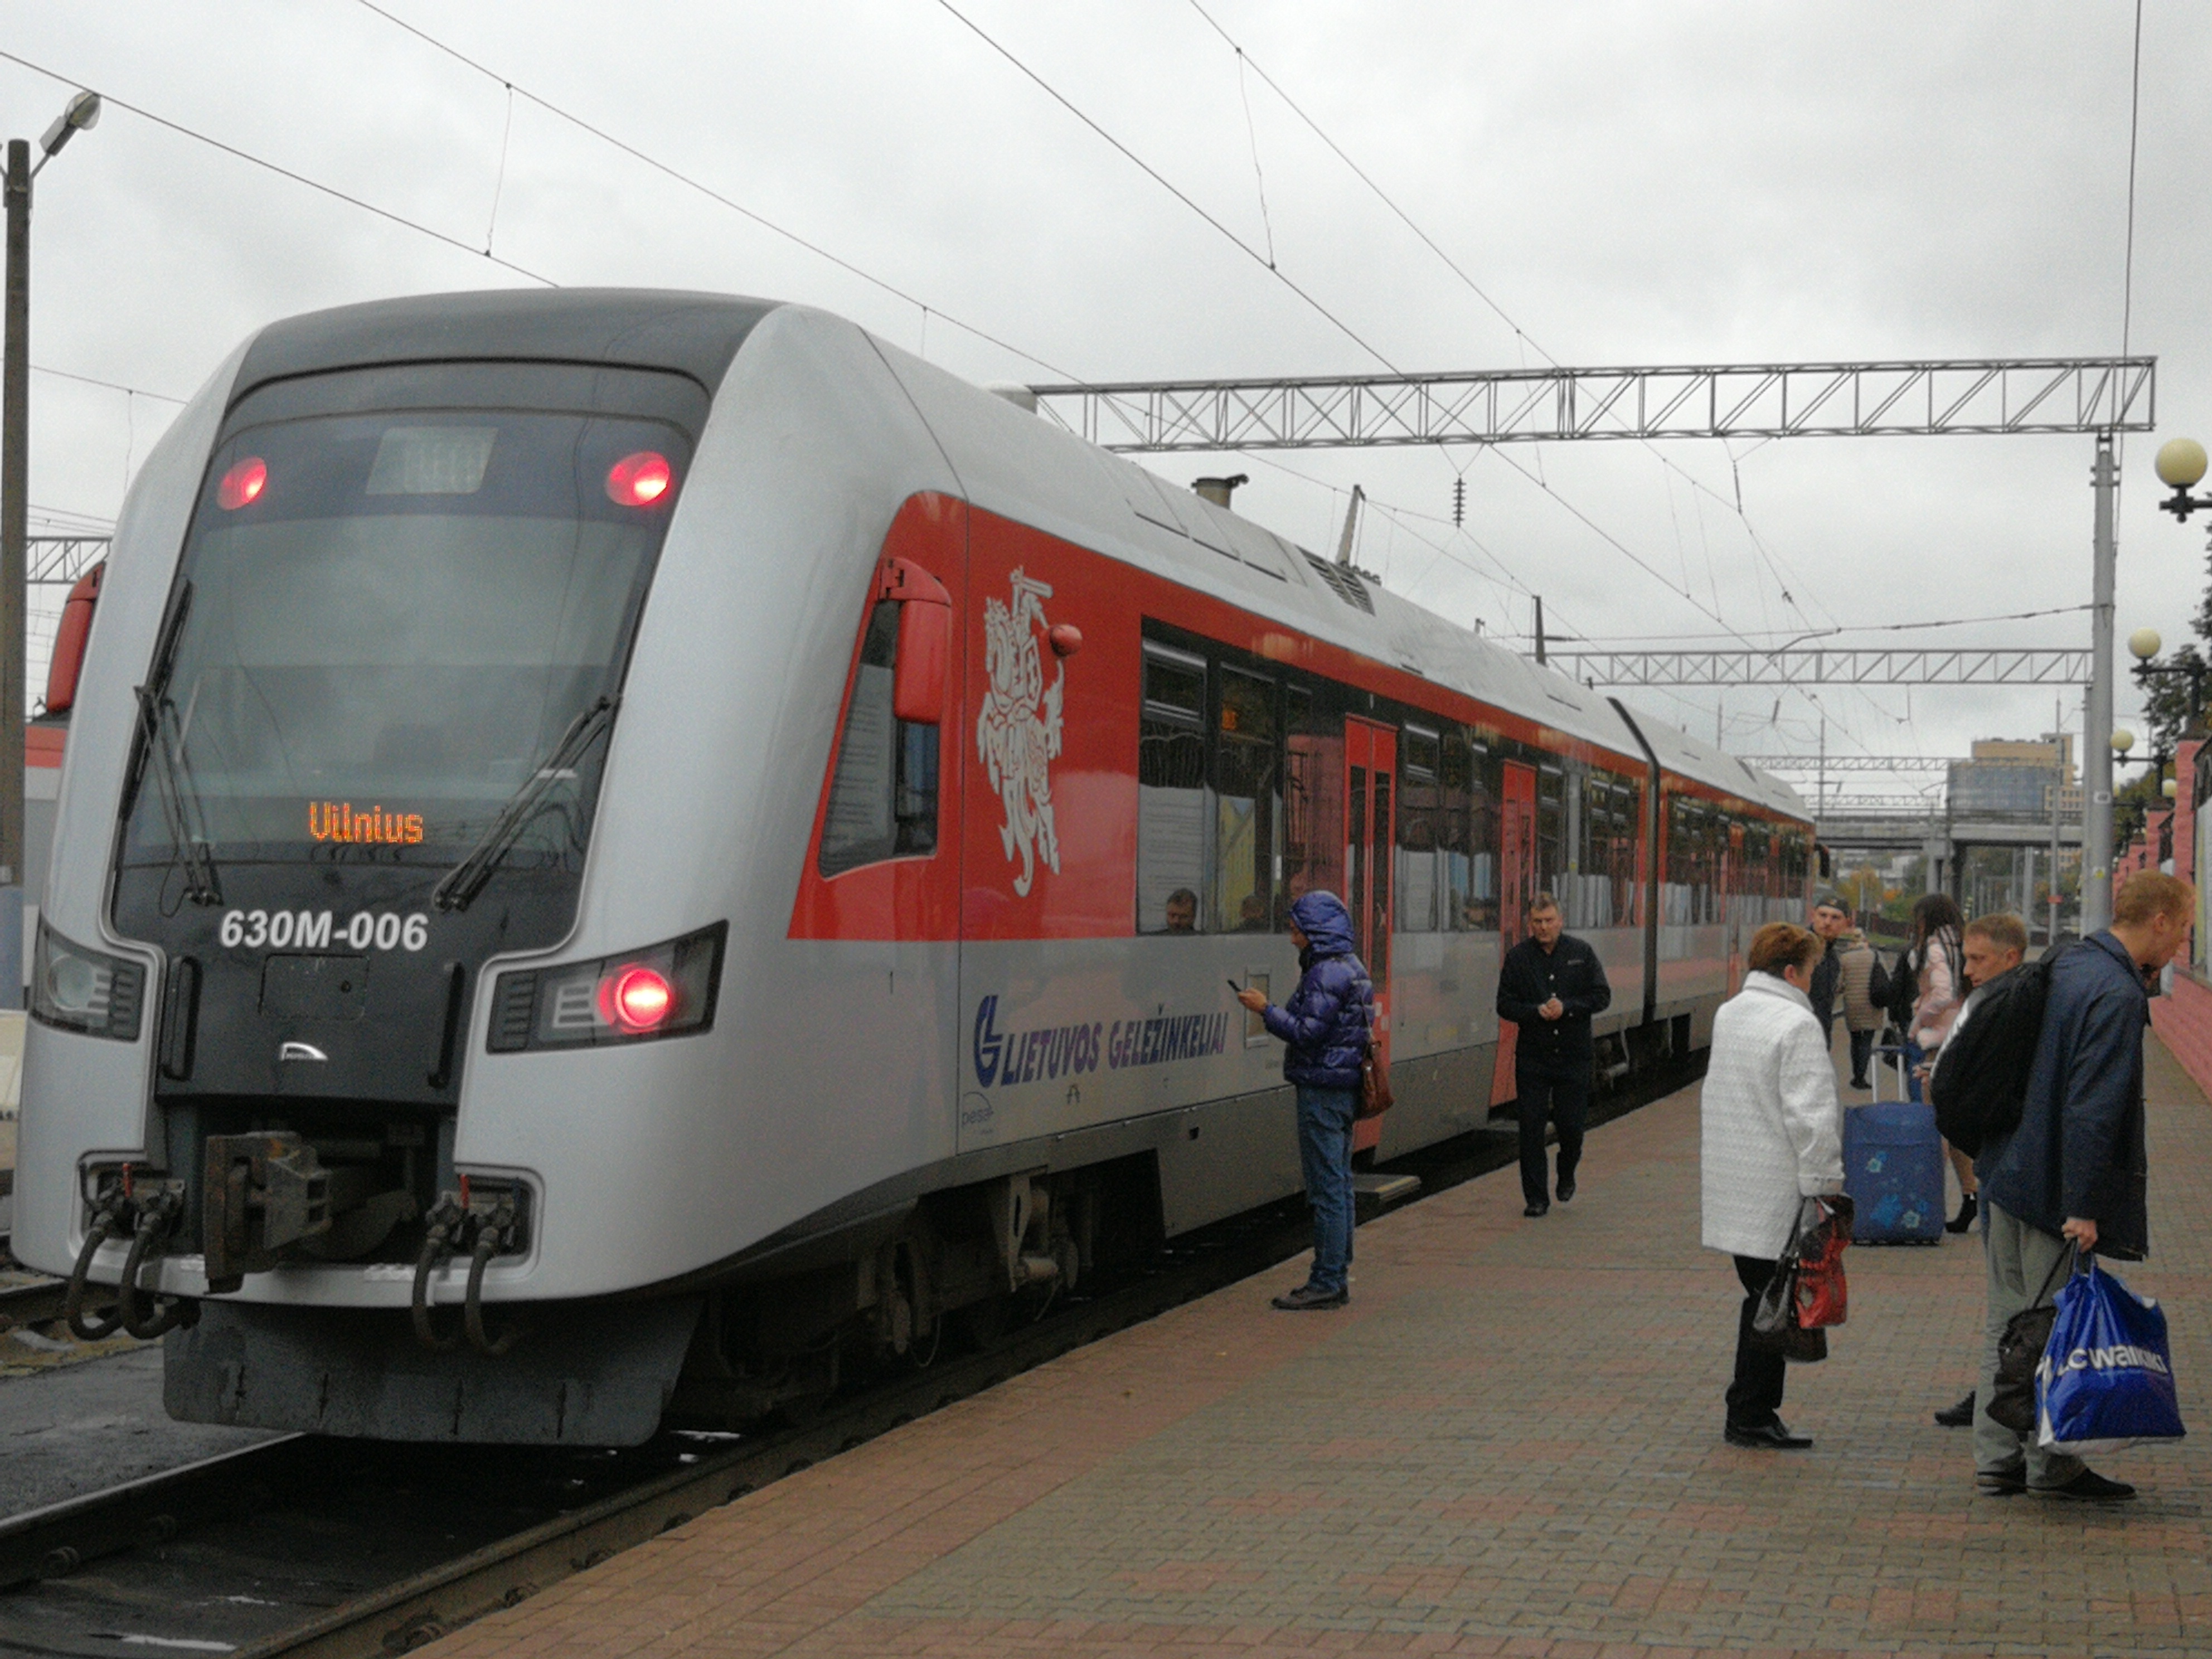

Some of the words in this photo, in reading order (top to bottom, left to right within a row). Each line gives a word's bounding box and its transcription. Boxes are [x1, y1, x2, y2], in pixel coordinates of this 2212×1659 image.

[311, 802, 423, 843] Vilnius
[221, 909, 429, 951] 630M-006
[1001, 1022, 1103, 1086] LIETUVOS
[1109, 1003, 1229, 1070] GELEŽINKELIAI
